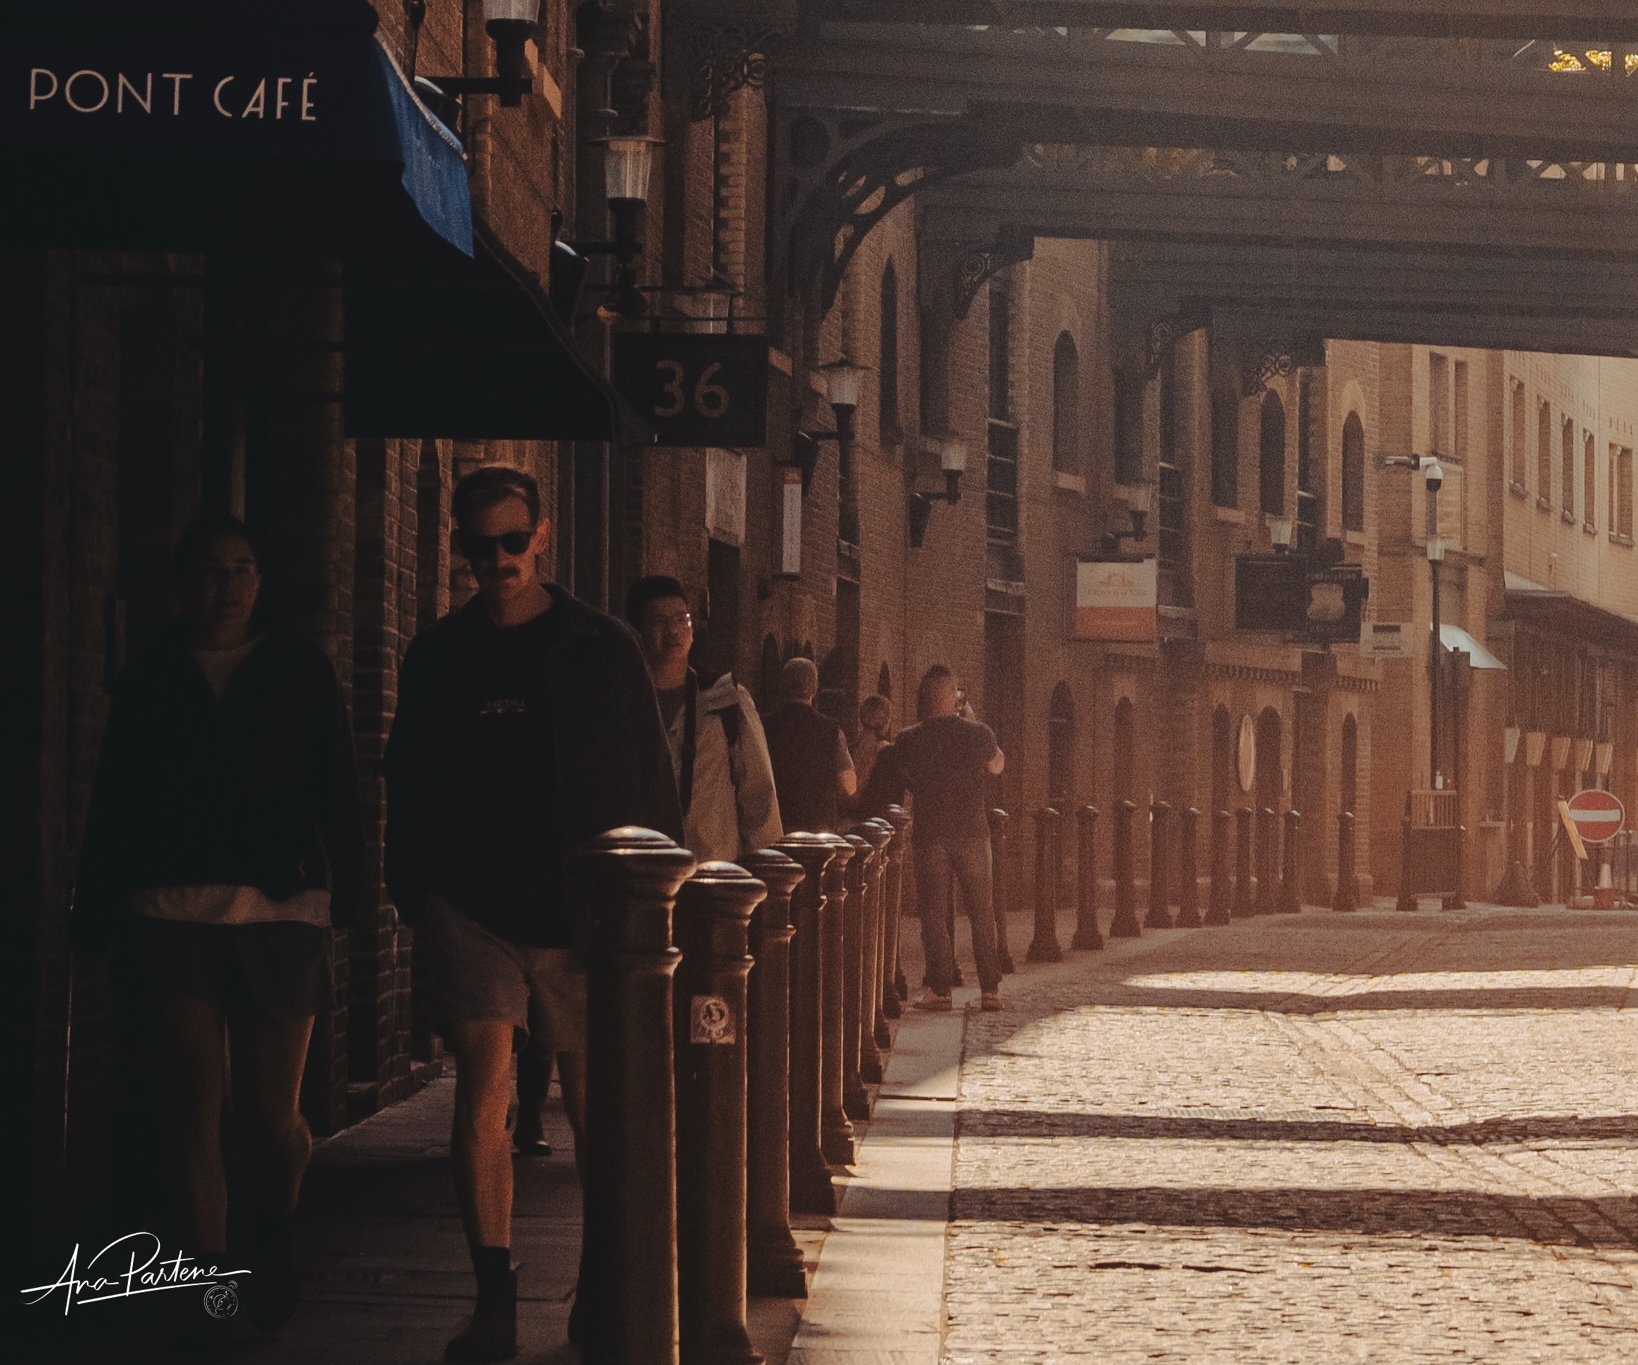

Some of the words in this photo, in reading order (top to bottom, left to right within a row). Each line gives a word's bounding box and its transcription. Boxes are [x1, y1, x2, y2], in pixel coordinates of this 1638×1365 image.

[28, 67, 193, 116] PONT
[213, 71, 318, 122] CAFÉ
[653, 358, 730, 419] 36
